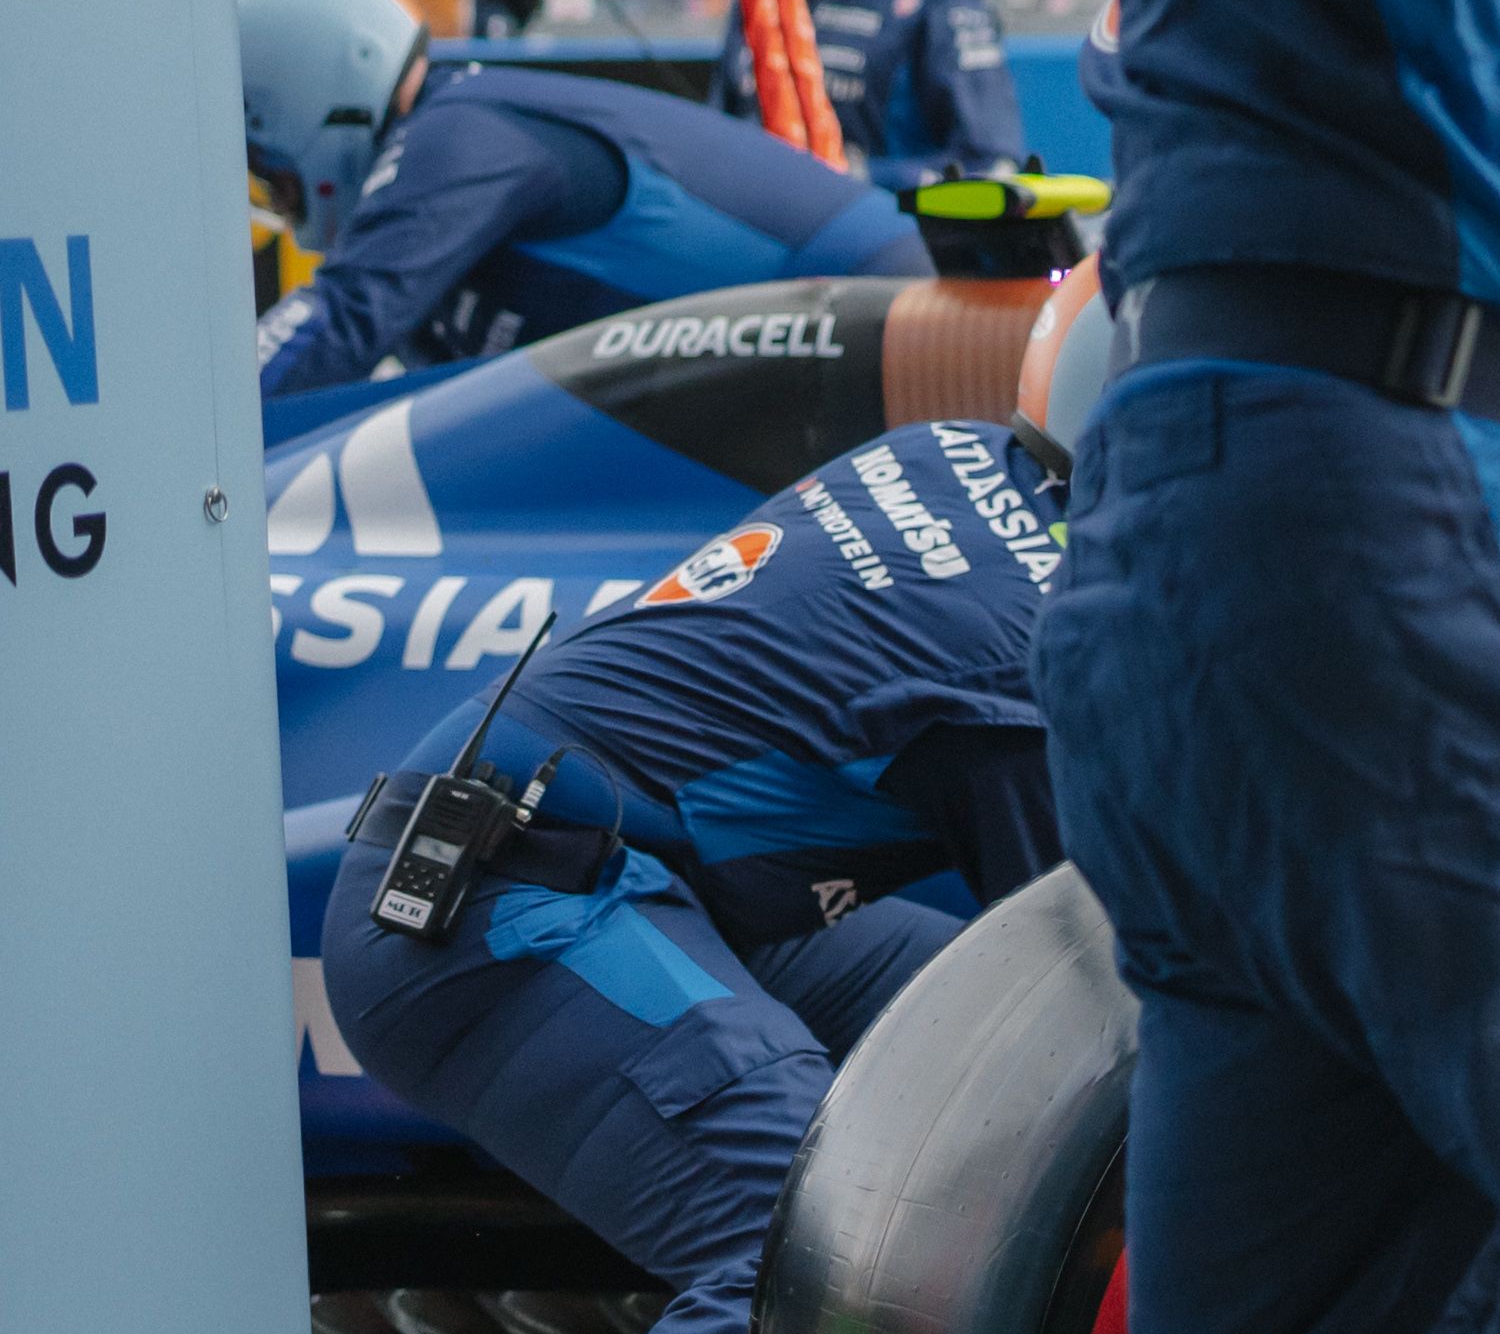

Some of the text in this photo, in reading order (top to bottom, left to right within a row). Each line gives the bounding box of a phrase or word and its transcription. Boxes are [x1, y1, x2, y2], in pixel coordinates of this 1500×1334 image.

[594, 313, 844, 359] DURACELL
[936, 424, 1062, 595] ATLASSIA
[270, 574, 645, 669] SIA
